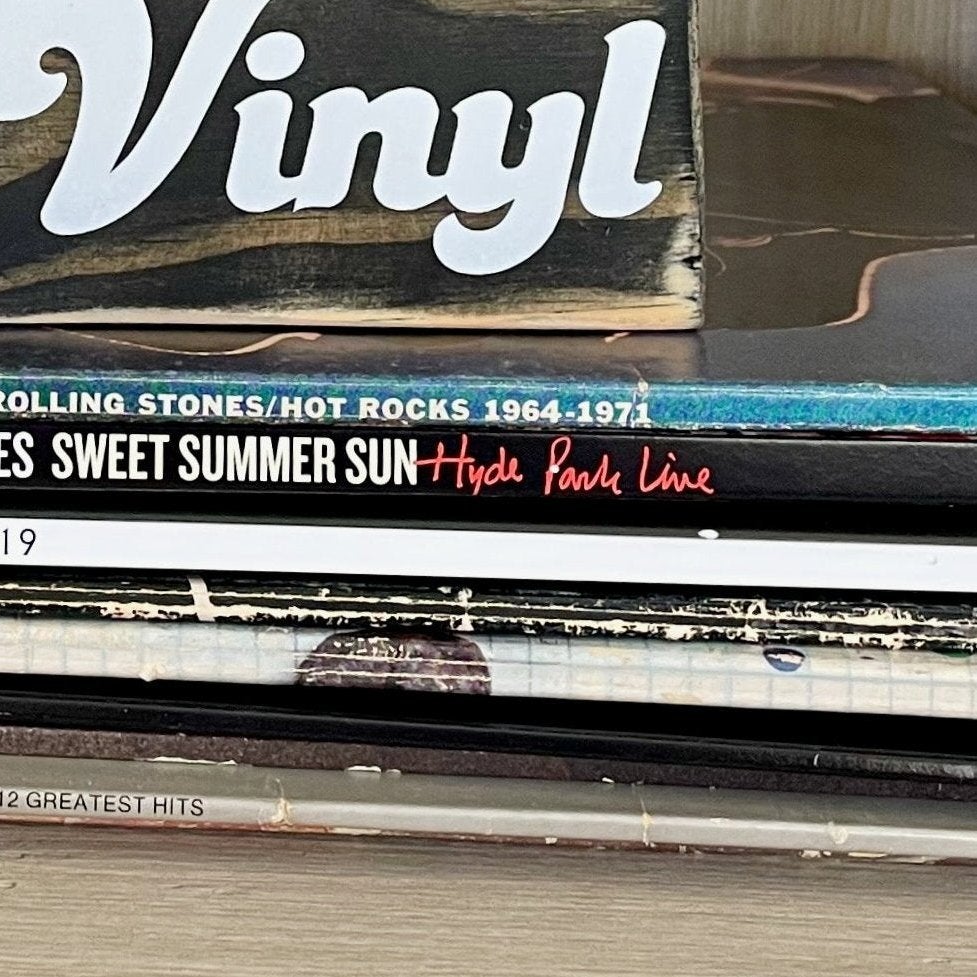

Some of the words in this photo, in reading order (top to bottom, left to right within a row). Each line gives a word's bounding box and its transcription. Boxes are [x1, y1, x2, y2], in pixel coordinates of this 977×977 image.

[359, 397, 470, 421] ROCKS
[485, 399, 652, 426] 1964-1971
[51, 432, 170, 480] SWEET
[178, 434, 336, 484] SUMMER
[345, 437, 418, 485] SUN
[414, 434, 523, 495] Hyde
[544, 435, 622, 495] Park
[639, 445, 715, 494] Live
[26, 791, 145, 814] GREATEST
[153, 795, 204, 817] HITS
